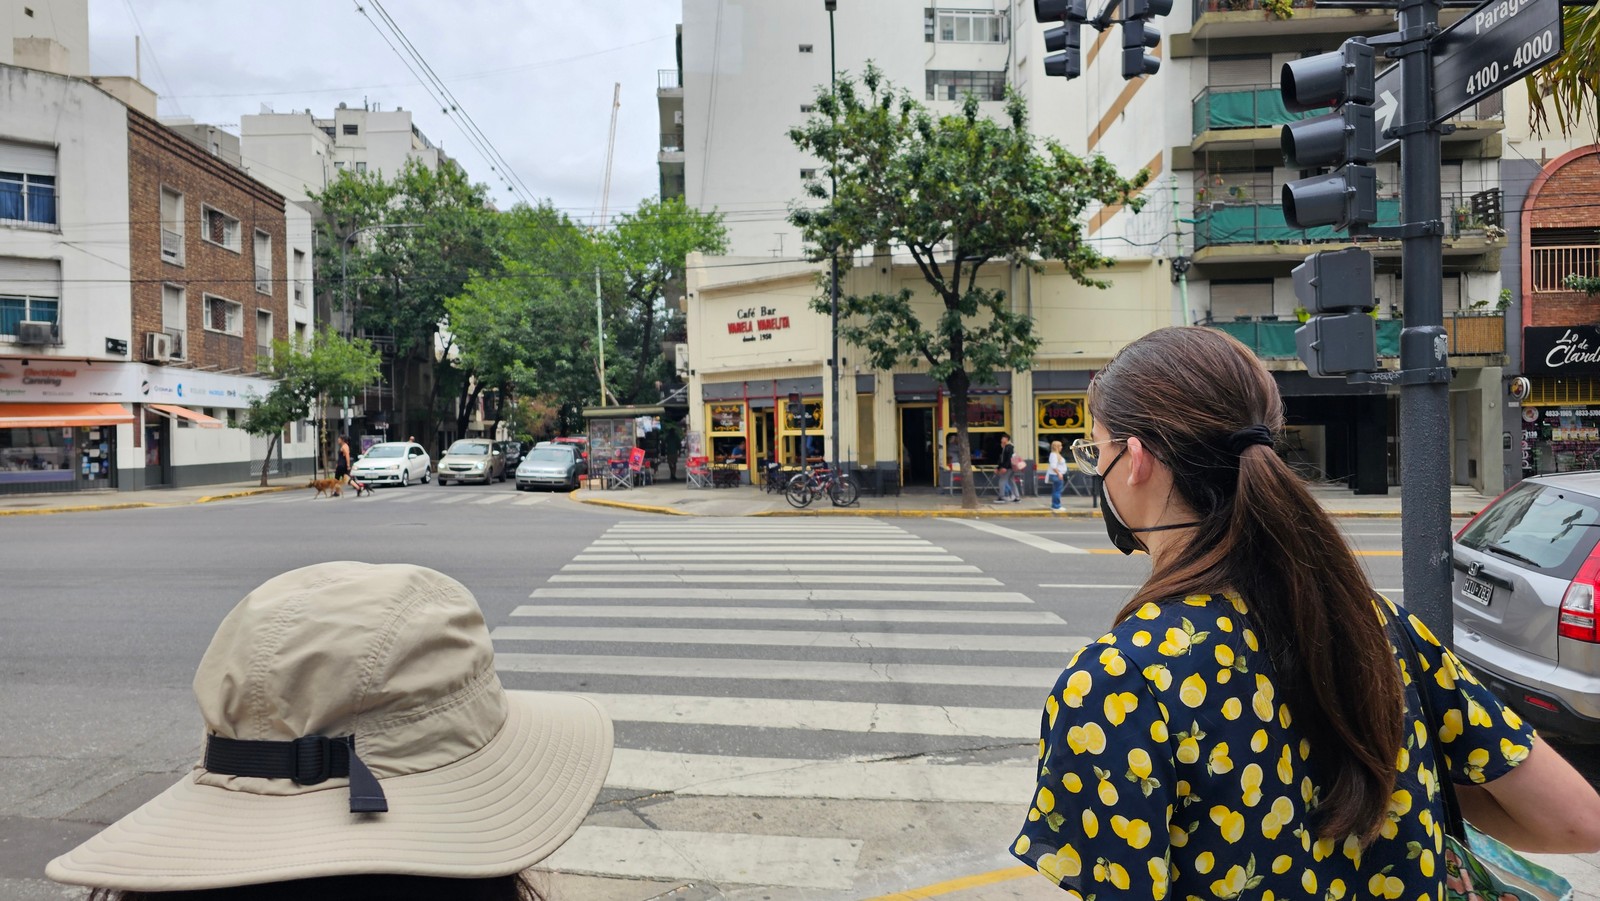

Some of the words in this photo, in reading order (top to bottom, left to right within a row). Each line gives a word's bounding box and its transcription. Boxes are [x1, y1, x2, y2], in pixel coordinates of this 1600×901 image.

[1466, 61, 1499, 95] 4100
[1513, 30, 1553, 69] 4000
[737, 307, 756, 319] Café
[760, 306, 776, 316] Bar
[727, 320, 754, 334] VARELA
[1555, 329, 1579, 344] Lo
[1577, 338, 1589, 350] de
[22, 377, 62, 387] Canning
